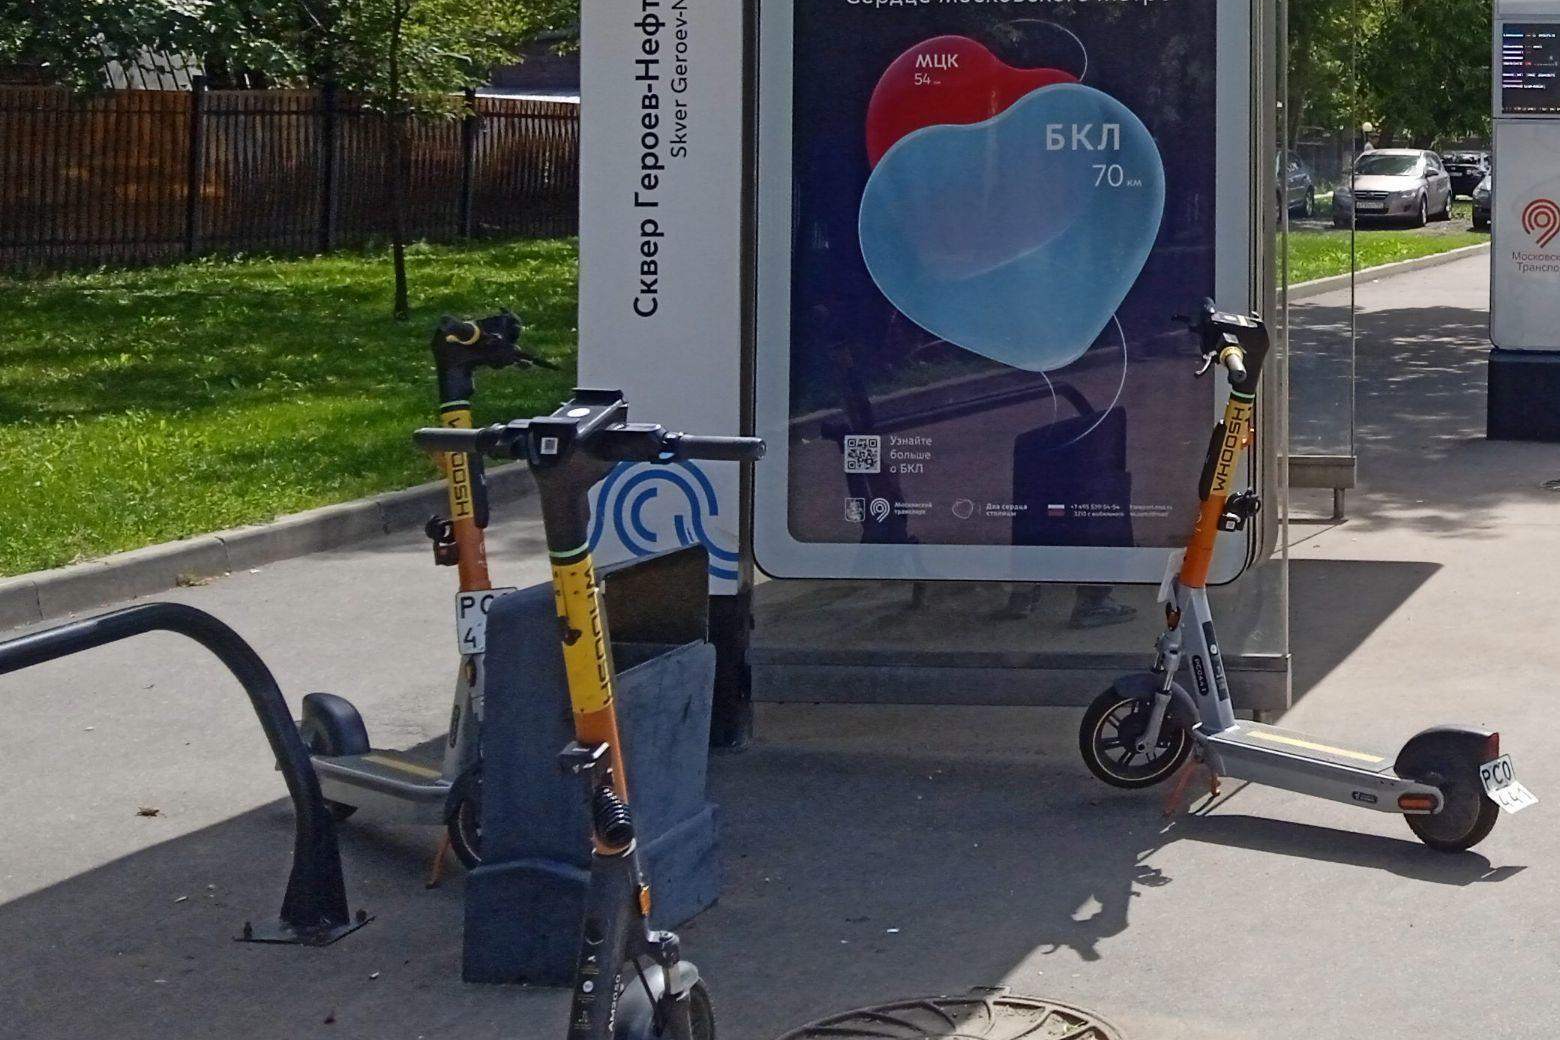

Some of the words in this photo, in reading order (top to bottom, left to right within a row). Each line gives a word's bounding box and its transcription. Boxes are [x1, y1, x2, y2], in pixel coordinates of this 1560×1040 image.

[915, 54, 959, 70] МЦК
[914, 73, 931, 85] 54
[670, 98, 688, 158] Skver
[1046, 123, 1121, 151] БКЛ
[1092, 164, 1124, 187] 70
[633, 218, 665, 318] Сквер
[889, 436, 933, 447] Узнайте
[1213, 407, 1245, 491] WHOOSH
[889, 450, 932, 460] больше
[890, 466, 897, 474] о
[900, 464, 925, 474] БКЛ
